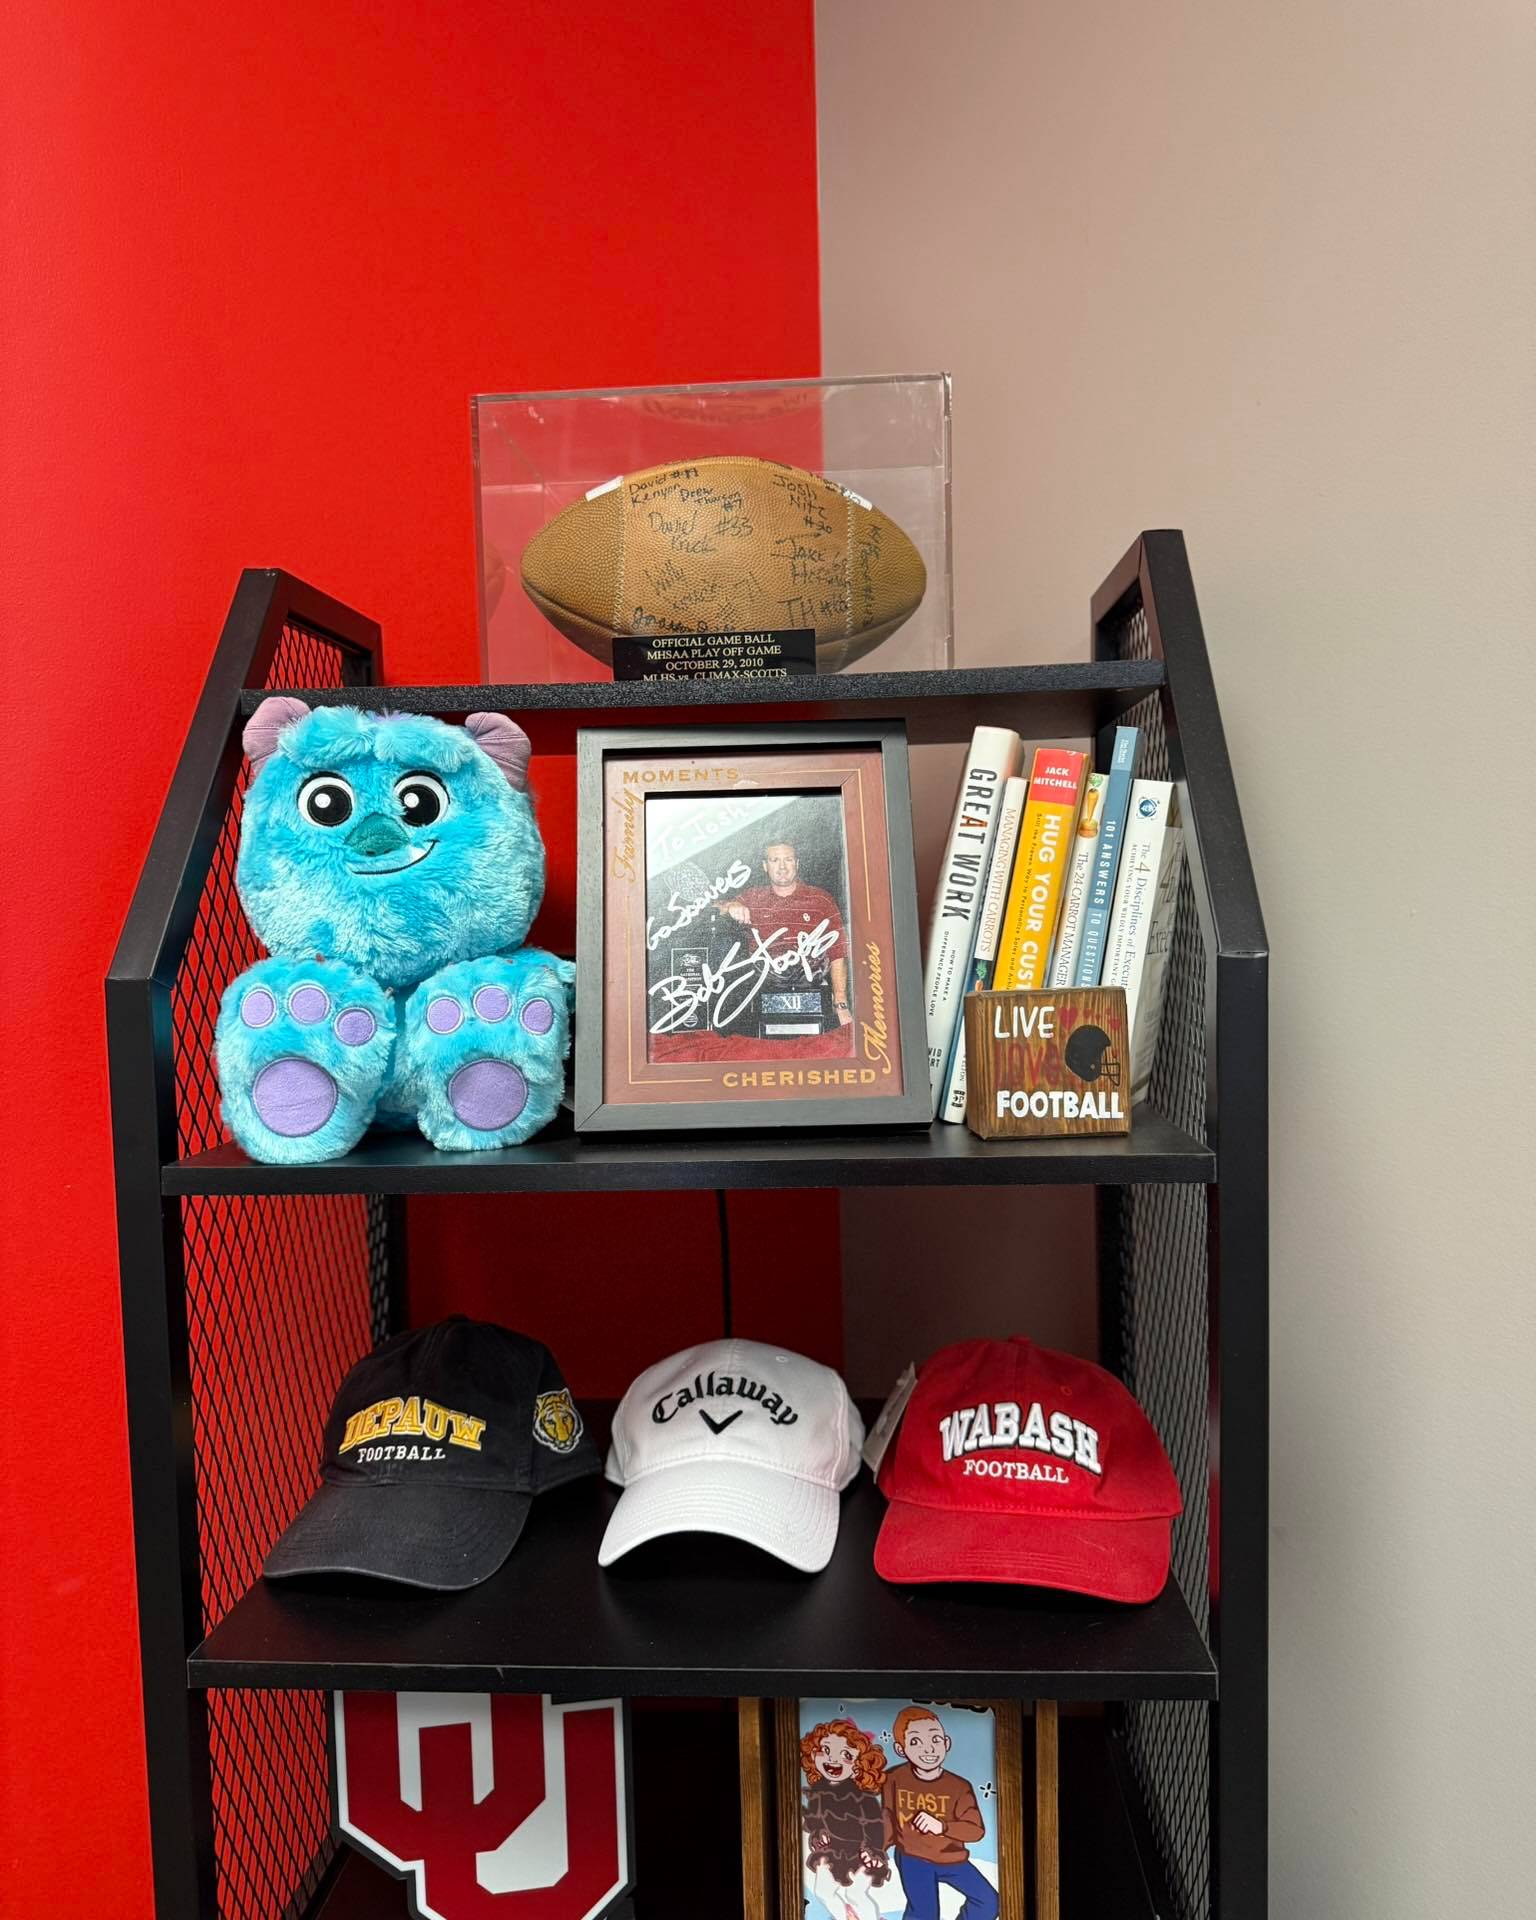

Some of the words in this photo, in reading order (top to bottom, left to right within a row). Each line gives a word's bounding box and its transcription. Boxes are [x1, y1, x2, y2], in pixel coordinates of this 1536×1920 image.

[629, 474, 666, 495] David
[772, 474, 817, 500] Josh
[647, 650, 689, 660] MHSAA
[691, 648, 720, 658] PLAY
[722, 647, 744, 656] OFF
[746, 645, 782, 655] GAME
[653, 637, 704, 648] OFFICIAL
[707, 636, 742, 646] GAME
[744, 634, 775, 644] BALL
[665, 660, 720, 671] OCTOBER
[722, 659, 737, 669] 29,
[740, 658, 763, 668] 2010
[694, 668, 787, 681] CLIMAX-SCOTTS
[623, 768, 739, 784] MOMENTS
[1034, 777, 1077, 788] MITCHELL
[1045, 767, 1069, 776] JACK
[958, 768, 998, 844] GREAT
[611, 788, 644, 884] Family
[996, 809, 1016, 868] MANAGING
[1038, 814, 1062, 863] HUG
[1105, 821, 1116, 838] 101
[1029, 842, 1037, 866] Proven
[1076, 852, 1088, 871] The
[1125, 844, 1137, 884] ACHIEVING
[1140, 843, 1150, 860] The
[1094, 844, 1112, 904] ANSWERS
[1134, 862, 1151, 873] 4
[942, 854, 981, 920] WORK
[990, 871, 1005, 900] WITH
[1025, 873, 1051, 932] YOUR
[1066, 872, 1086, 931] 24-CARROT
[1128, 878, 1148, 936] Disciplines
[981, 904, 998, 952] CARROTS
[1016, 896, 1027, 934] Personalize
[1090, 913, 1102, 925] TO
[1118, 907, 1127, 932] WILDLY
[937, 931, 950, 970] DIFFERENCE
[948, 950, 956, 967] HOW
[1056, 932, 1074, 986] MANAGER
[1080, 931, 1099, 987] QUESTIONS
[1112, 935, 1123, 976] IMPORTANT
[1016, 941, 1039, 991] CUST
[932, 972, 941, 998] PEOPLE
[943, 978, 951, 994] MAKE
[781, 995, 800, 1009] XII
[860, 941, 892, 1075] Memories
[929, 1000, 937, 1016] LOVE
[994, 1005, 1055, 1039] LIVE
[723, 1069, 876, 1088] CHERISHED
[996, 1090, 1124, 1119] FOOTBALL
[652, 1370, 798, 1425] Callaway
[338, 1396, 486, 1454] DEPAUW
[939, 1402, 1102, 1474] WABASH
[357, 1446, 446, 1463] FOOTBALL
[963, 1458, 1070, 1484] FOOTBALL
[898, 1789, 950, 1812] FEAST
